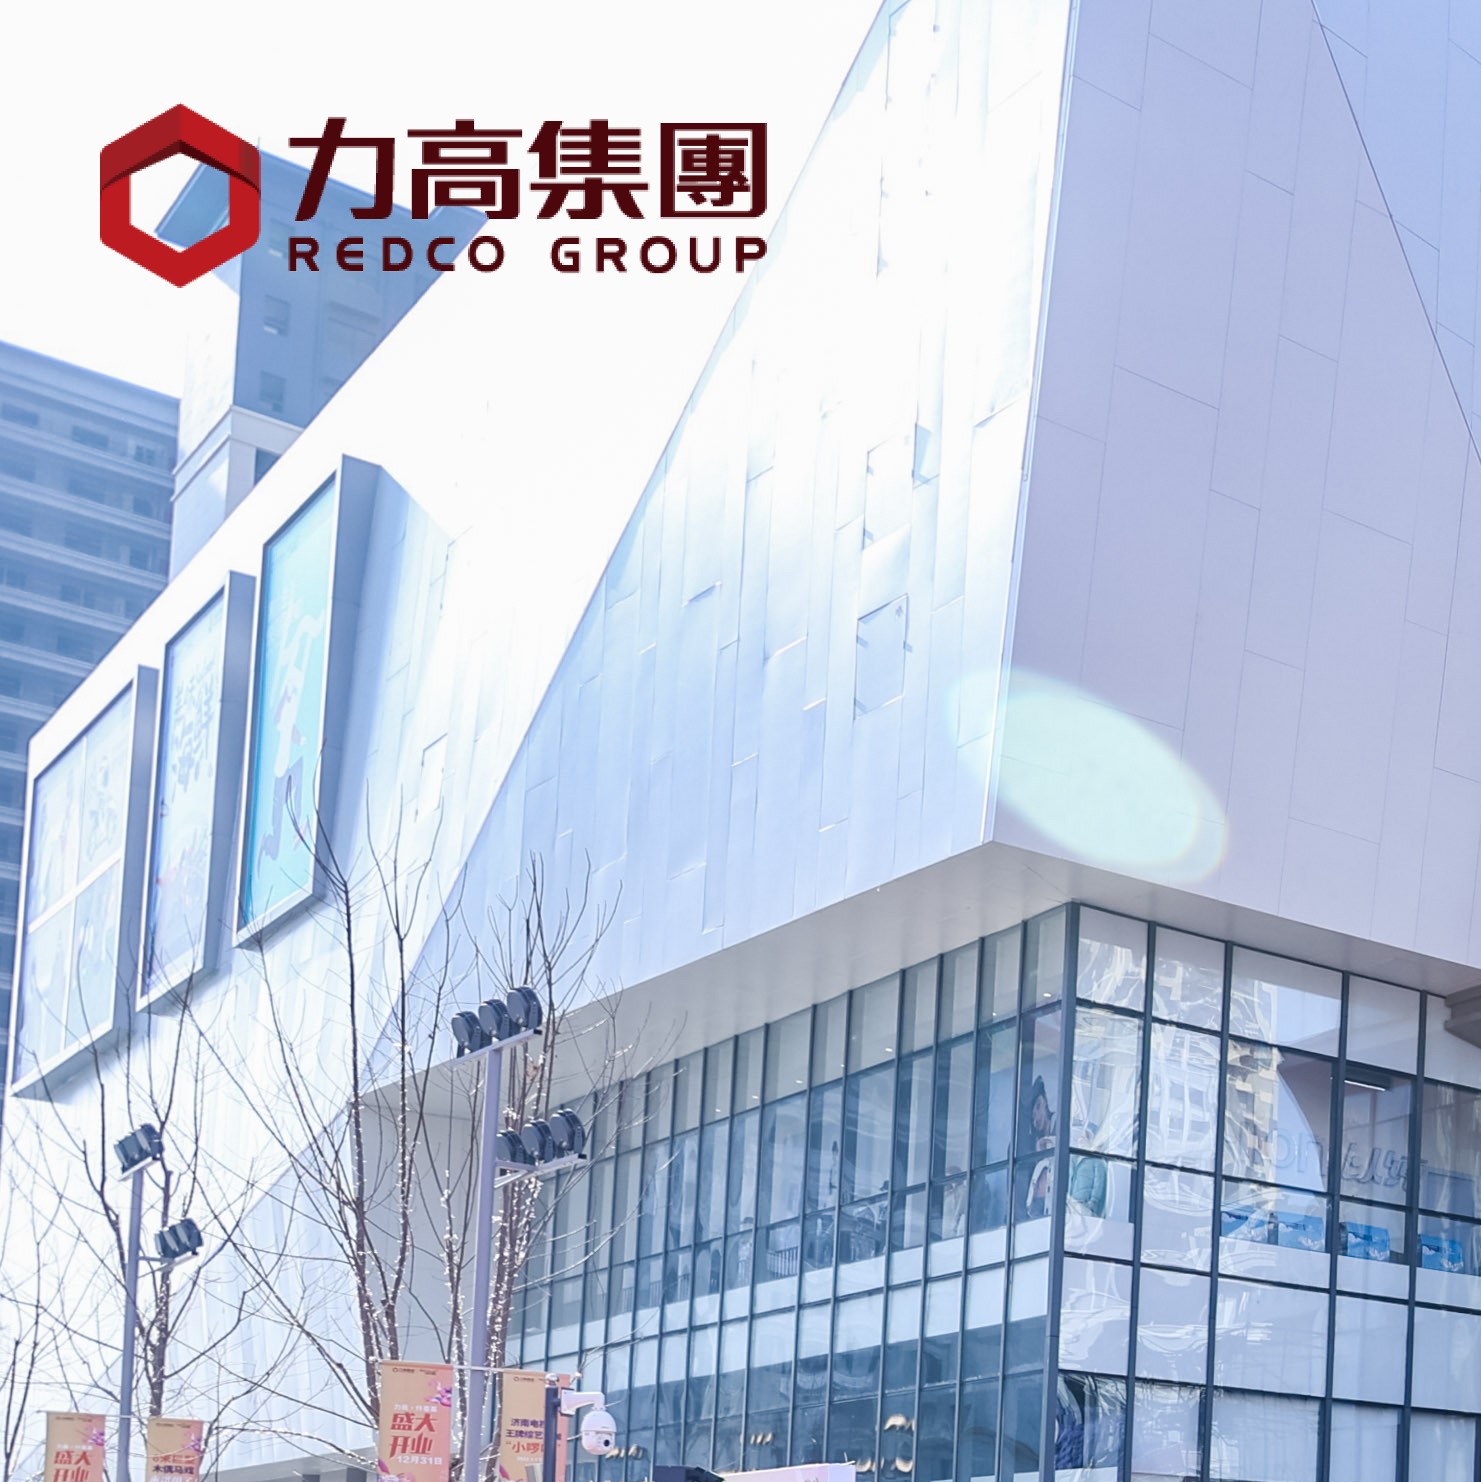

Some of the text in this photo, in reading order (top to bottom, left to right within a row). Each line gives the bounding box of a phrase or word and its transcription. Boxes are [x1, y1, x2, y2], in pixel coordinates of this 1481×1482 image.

[390, 1412, 438, 1432] 盛大
[389, 1432, 433, 1458] 开业
[54, 1450, 92, 1466] 盛大
[397, 1455, 443, 1465] 12月31日
